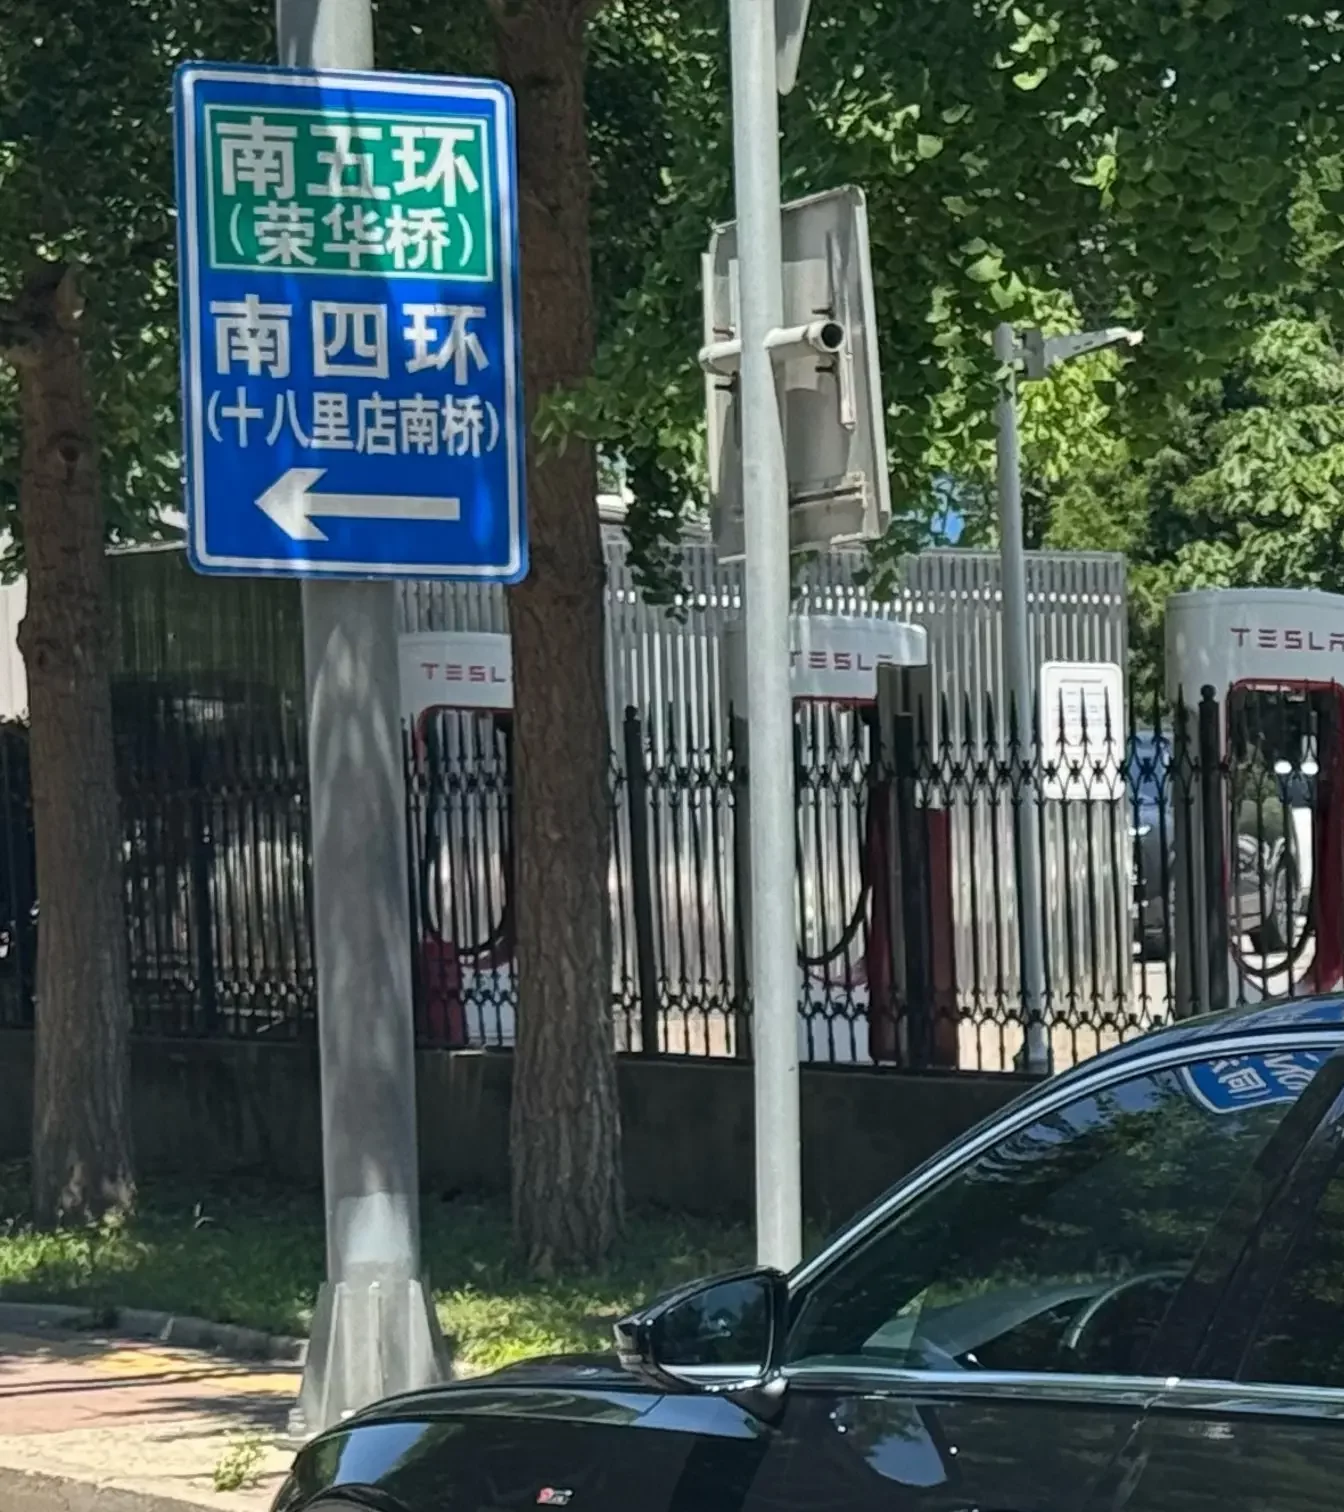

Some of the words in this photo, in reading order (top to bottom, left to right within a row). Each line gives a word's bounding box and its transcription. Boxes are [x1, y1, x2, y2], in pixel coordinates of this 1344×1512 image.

[214, 116, 479, 207] 南五环
[229, 201, 474, 270] (荣华桥)
[209, 293, 490, 386] 南四环
[207, 386, 500, 458] (十八里店南桥)
[420, 661, 507, 684] TESL
